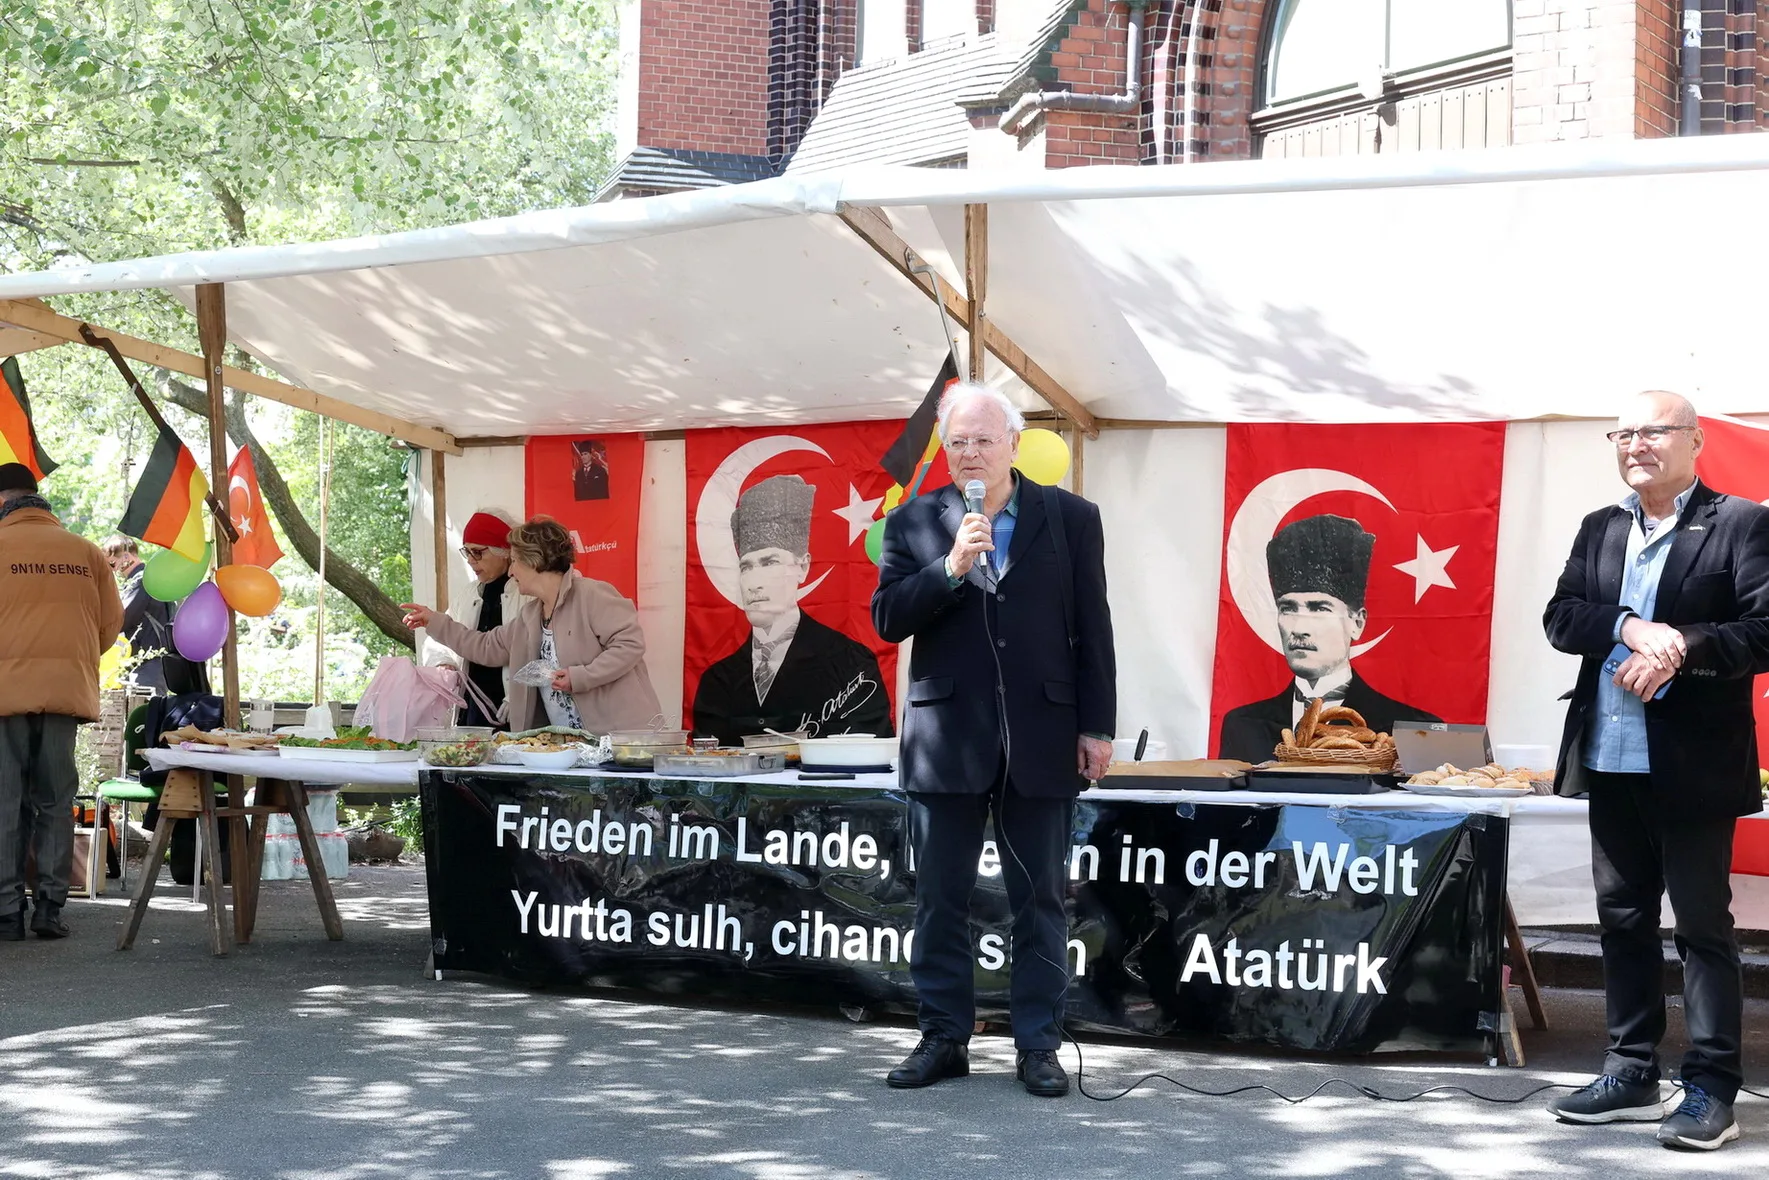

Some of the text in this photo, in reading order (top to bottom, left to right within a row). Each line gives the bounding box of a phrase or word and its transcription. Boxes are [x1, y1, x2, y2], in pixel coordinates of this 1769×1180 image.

[10, 563, 92, 578] 9N1M SENSE.
[496, 804, 653, 856] Frieden
[668, 813, 720, 860] im
[736, 817, 890, 880] Lande,
[1119, 834, 1165, 885] in
[1185, 838, 1277, 889] der
[1292, 841, 1419, 897] Welt
[511, 889, 632, 943] Yurtta
[646, 903, 754, 962] sulh,
[1180, 933, 1389, 995] Atatürk
